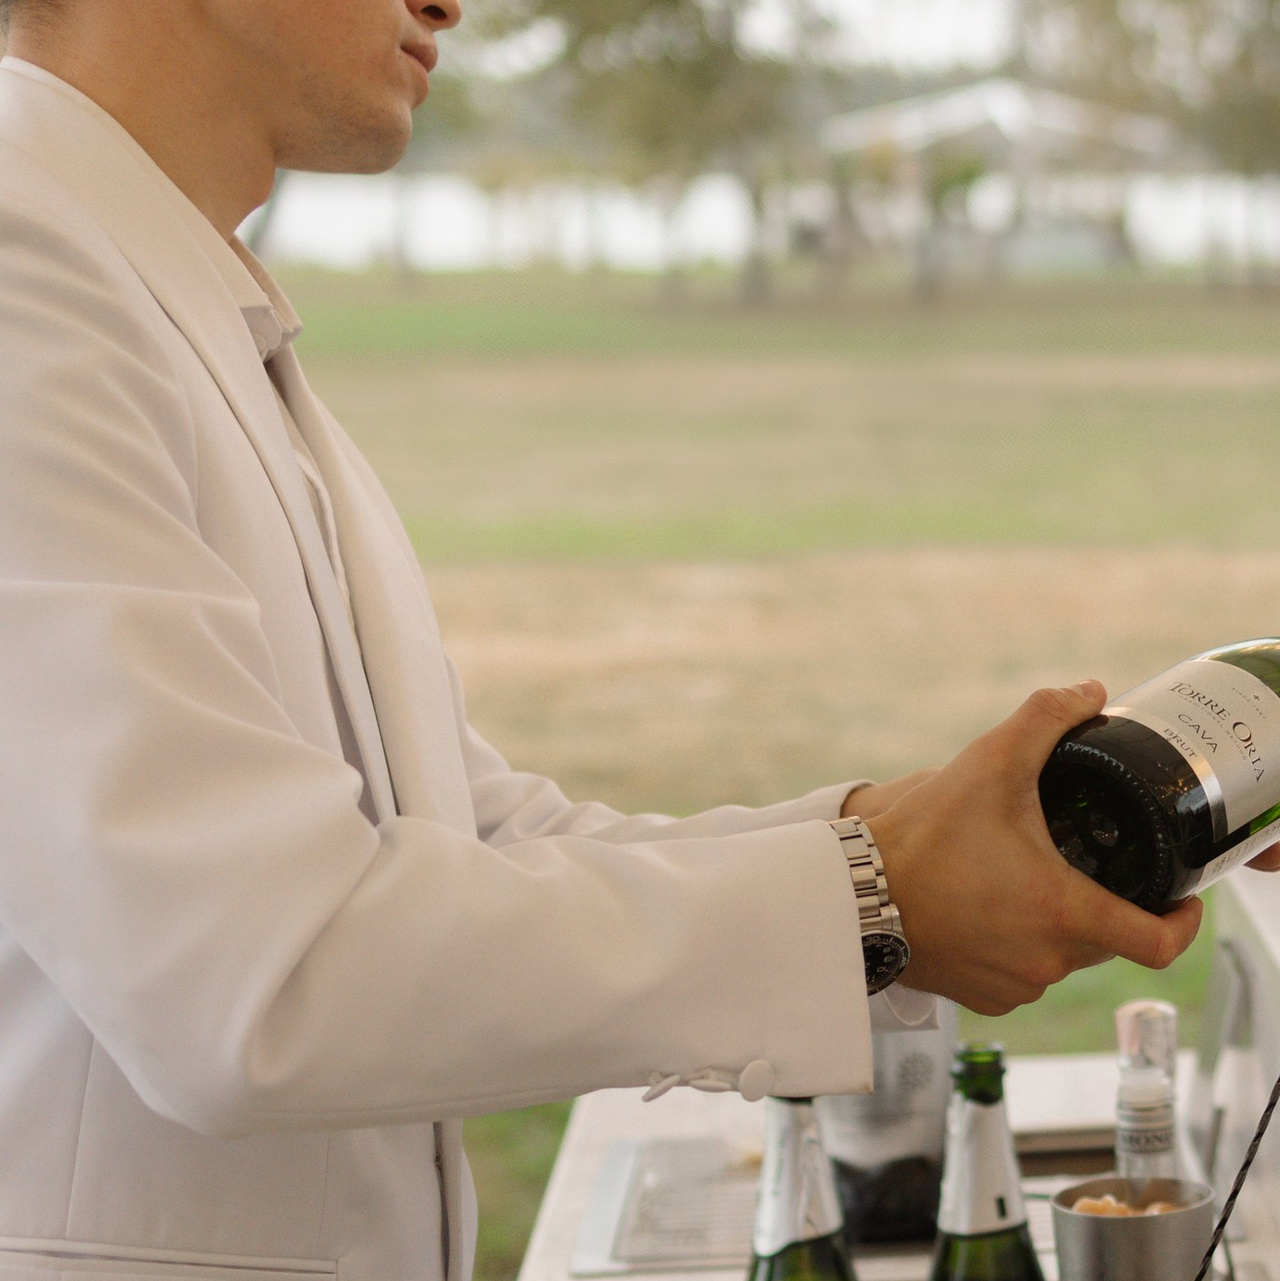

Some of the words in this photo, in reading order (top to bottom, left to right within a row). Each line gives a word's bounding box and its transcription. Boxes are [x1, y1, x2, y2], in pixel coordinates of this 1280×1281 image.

[1163, 728, 1198, 758] BRUT
[1169, 681, 1230, 721] TORRE
[1232, 721, 1265, 782] ORIA
[1178, 713, 1218, 754] CAVA
